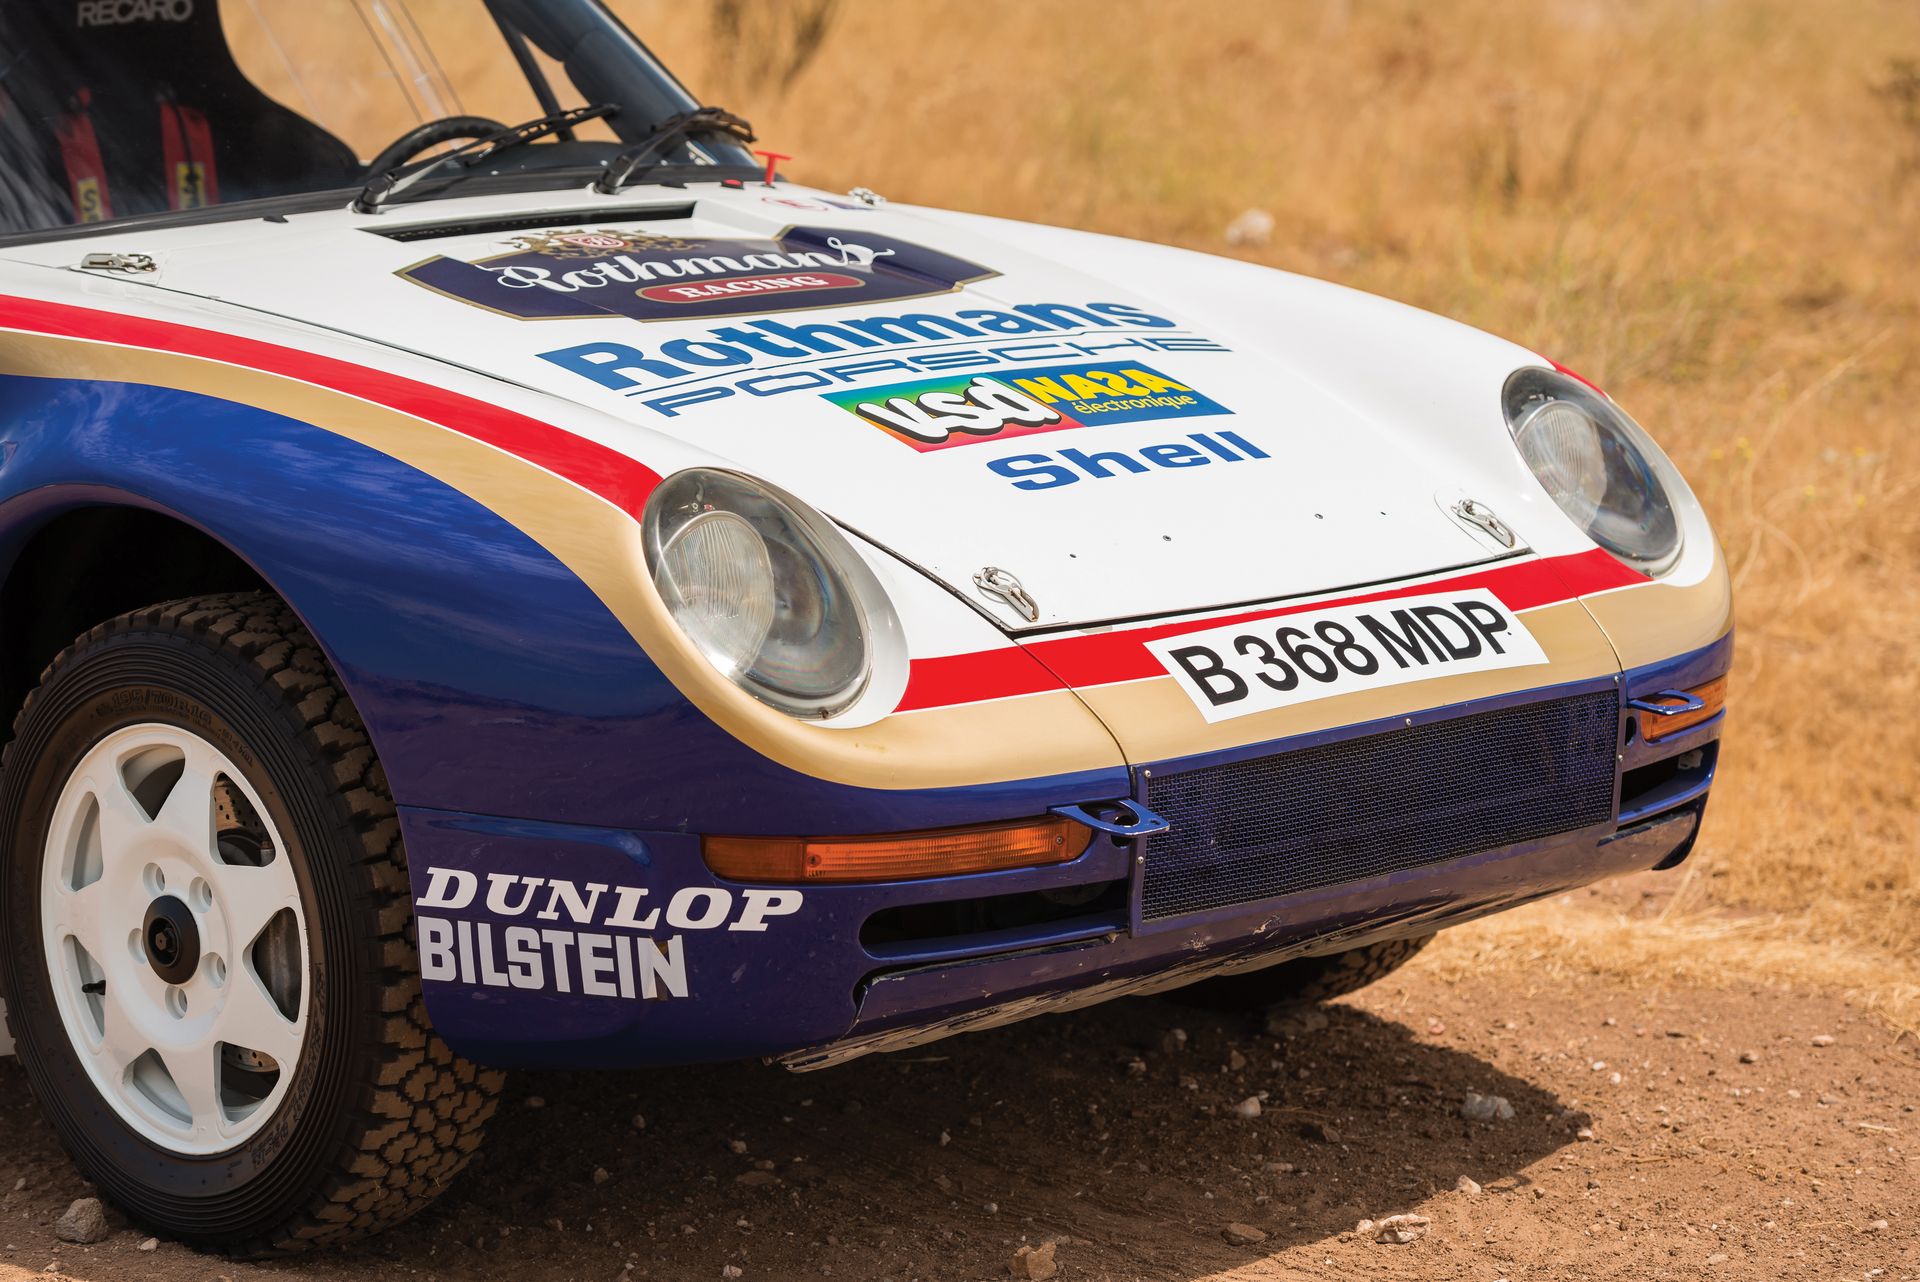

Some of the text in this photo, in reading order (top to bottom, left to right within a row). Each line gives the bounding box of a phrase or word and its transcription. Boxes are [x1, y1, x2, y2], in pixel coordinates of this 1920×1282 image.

[77, 0, 194, 27] RECARO
[477, 236, 895, 293] Rothmans
[668, 275, 828, 299] RACING
[534, 302, 1177, 391] Rothmans
[640, 337, 1233, 418] PORSCHE
[1011, 368, 1194, 404] NASA
[1072, 393, 1199, 416] électronique
[986, 430, 1272, 491] Shell
[1354, 600, 1509, 669] MDP
[415, 866, 804, 932] DUNLOP
[417, 915, 689, 1000] BILSTEIN
